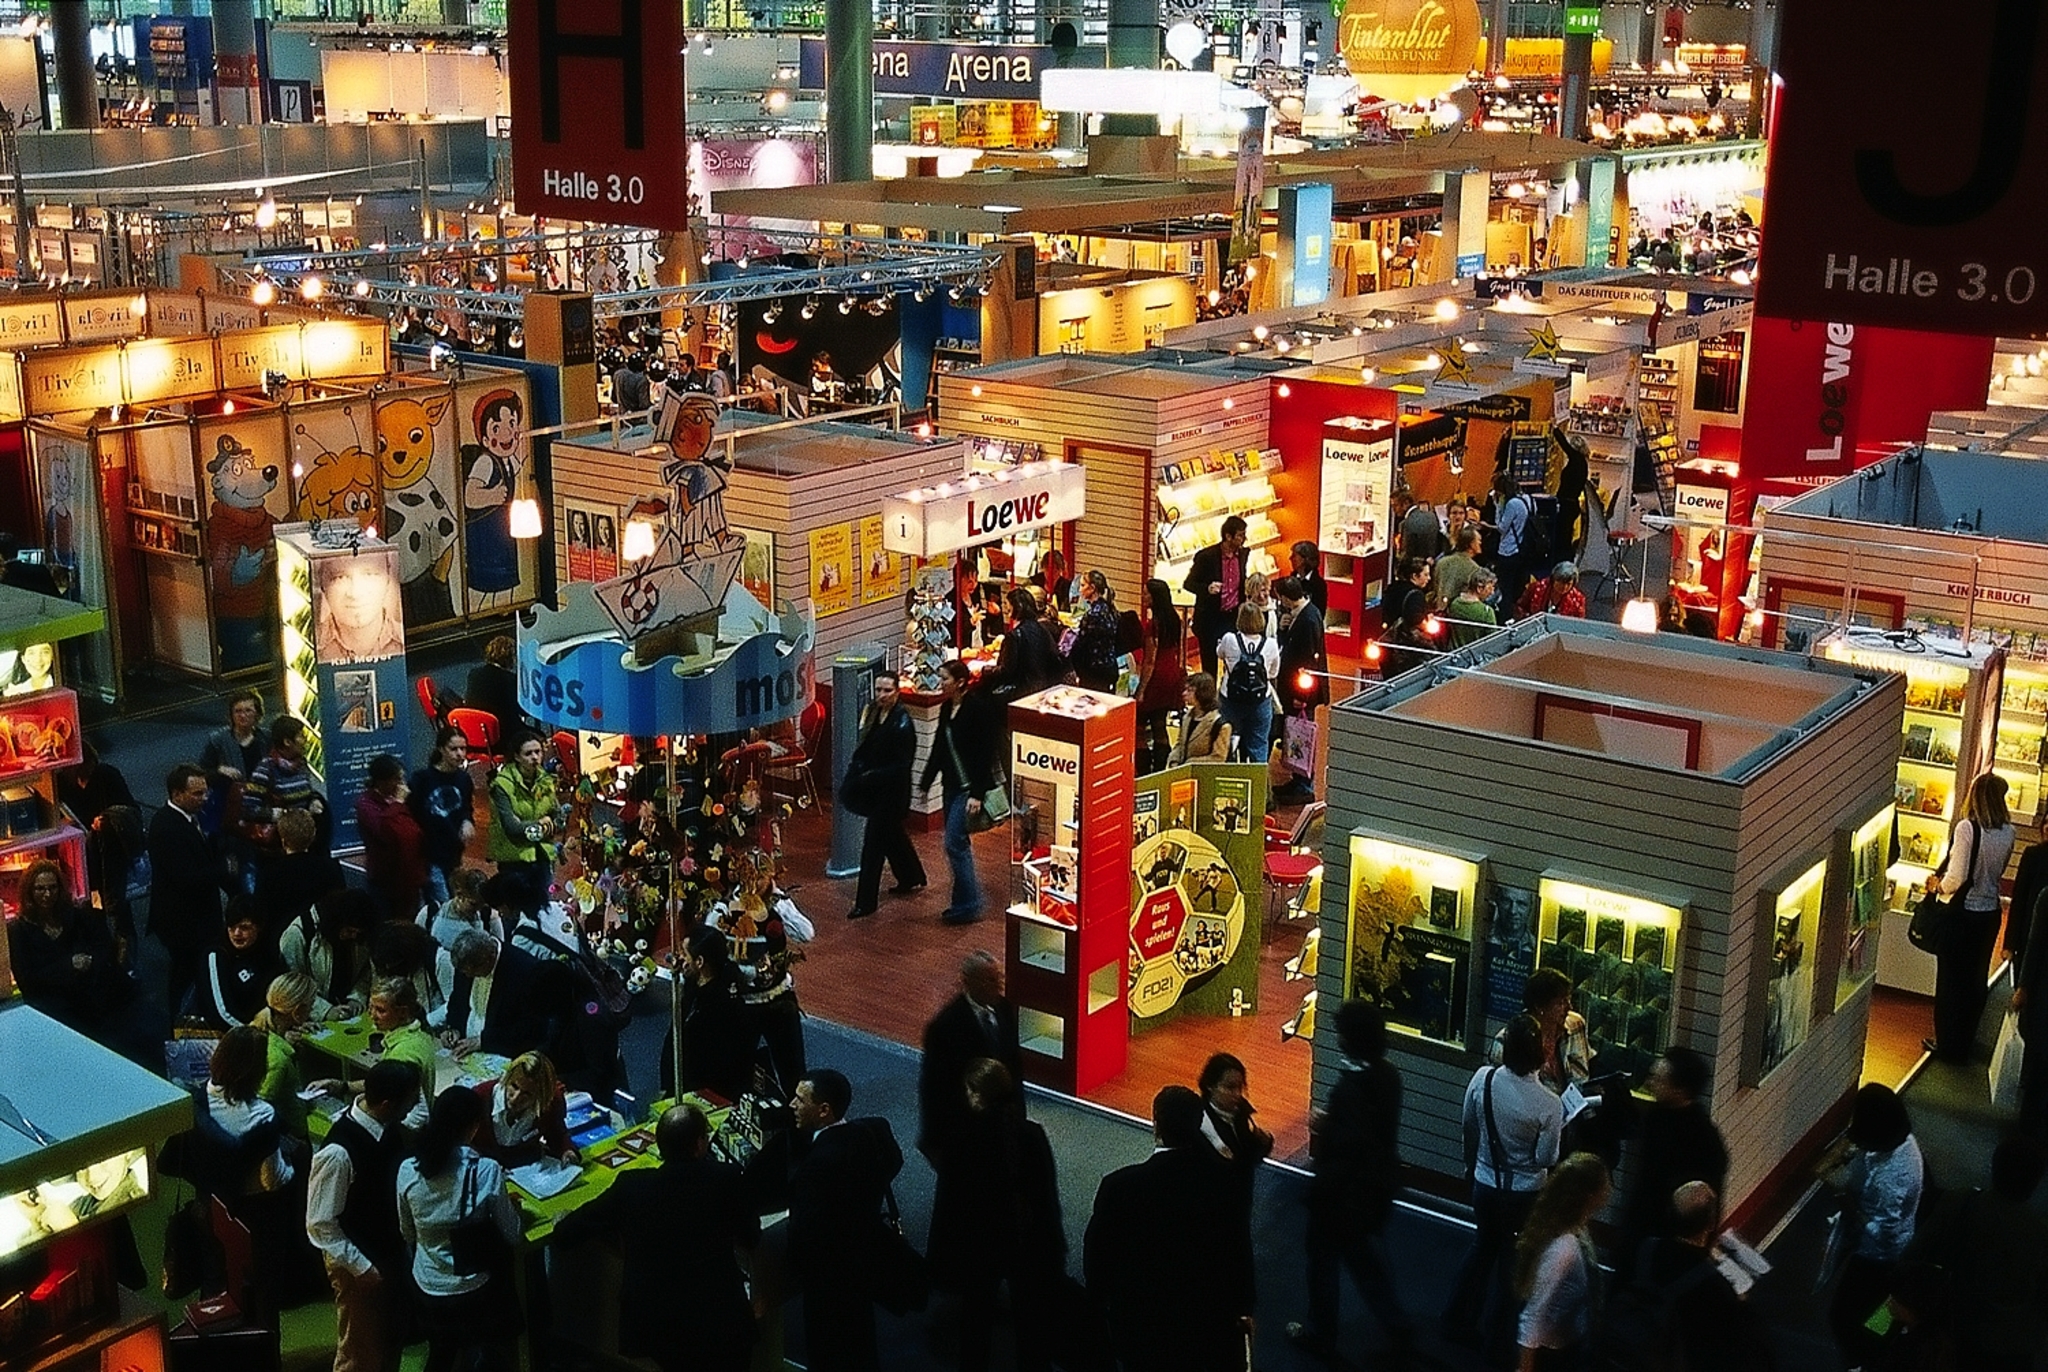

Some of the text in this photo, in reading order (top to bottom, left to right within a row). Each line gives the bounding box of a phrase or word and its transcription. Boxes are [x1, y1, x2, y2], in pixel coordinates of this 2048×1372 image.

[1340, 0, 1451, 52] Tintenblut
[872, 51, 909, 77] ena
[1350, 50, 1441, 61] CORNELIA FUNKE
[538, 0, 645, 150] H
[945, 53, 1032, 92] Arena
[544, 169, 644, 204] Halle 3.0
[1824, 253, 2036, 304] Halle 3.0
[1559, 286, 1576, 296] DAS
[1579, 287, 1631, 300] ABENTEUER
[1805, 321, 1855, 462] Loewe
[981, 414, 1020, 427] SACHBUCH
[1325, 446, 1365, 464] Loewe
[1368, 448, 1391, 464] Loewe
[1678, 491, 1725, 511] Loewe
[967, 490, 1050, 539] Loewe
[1947, 584, 2033, 605] KINDERBUCH
[1017, 743, 1077, 775] Loewe
[1151, 914, 1168, 931] und
[1144, 926, 1176, 948] spielen!
